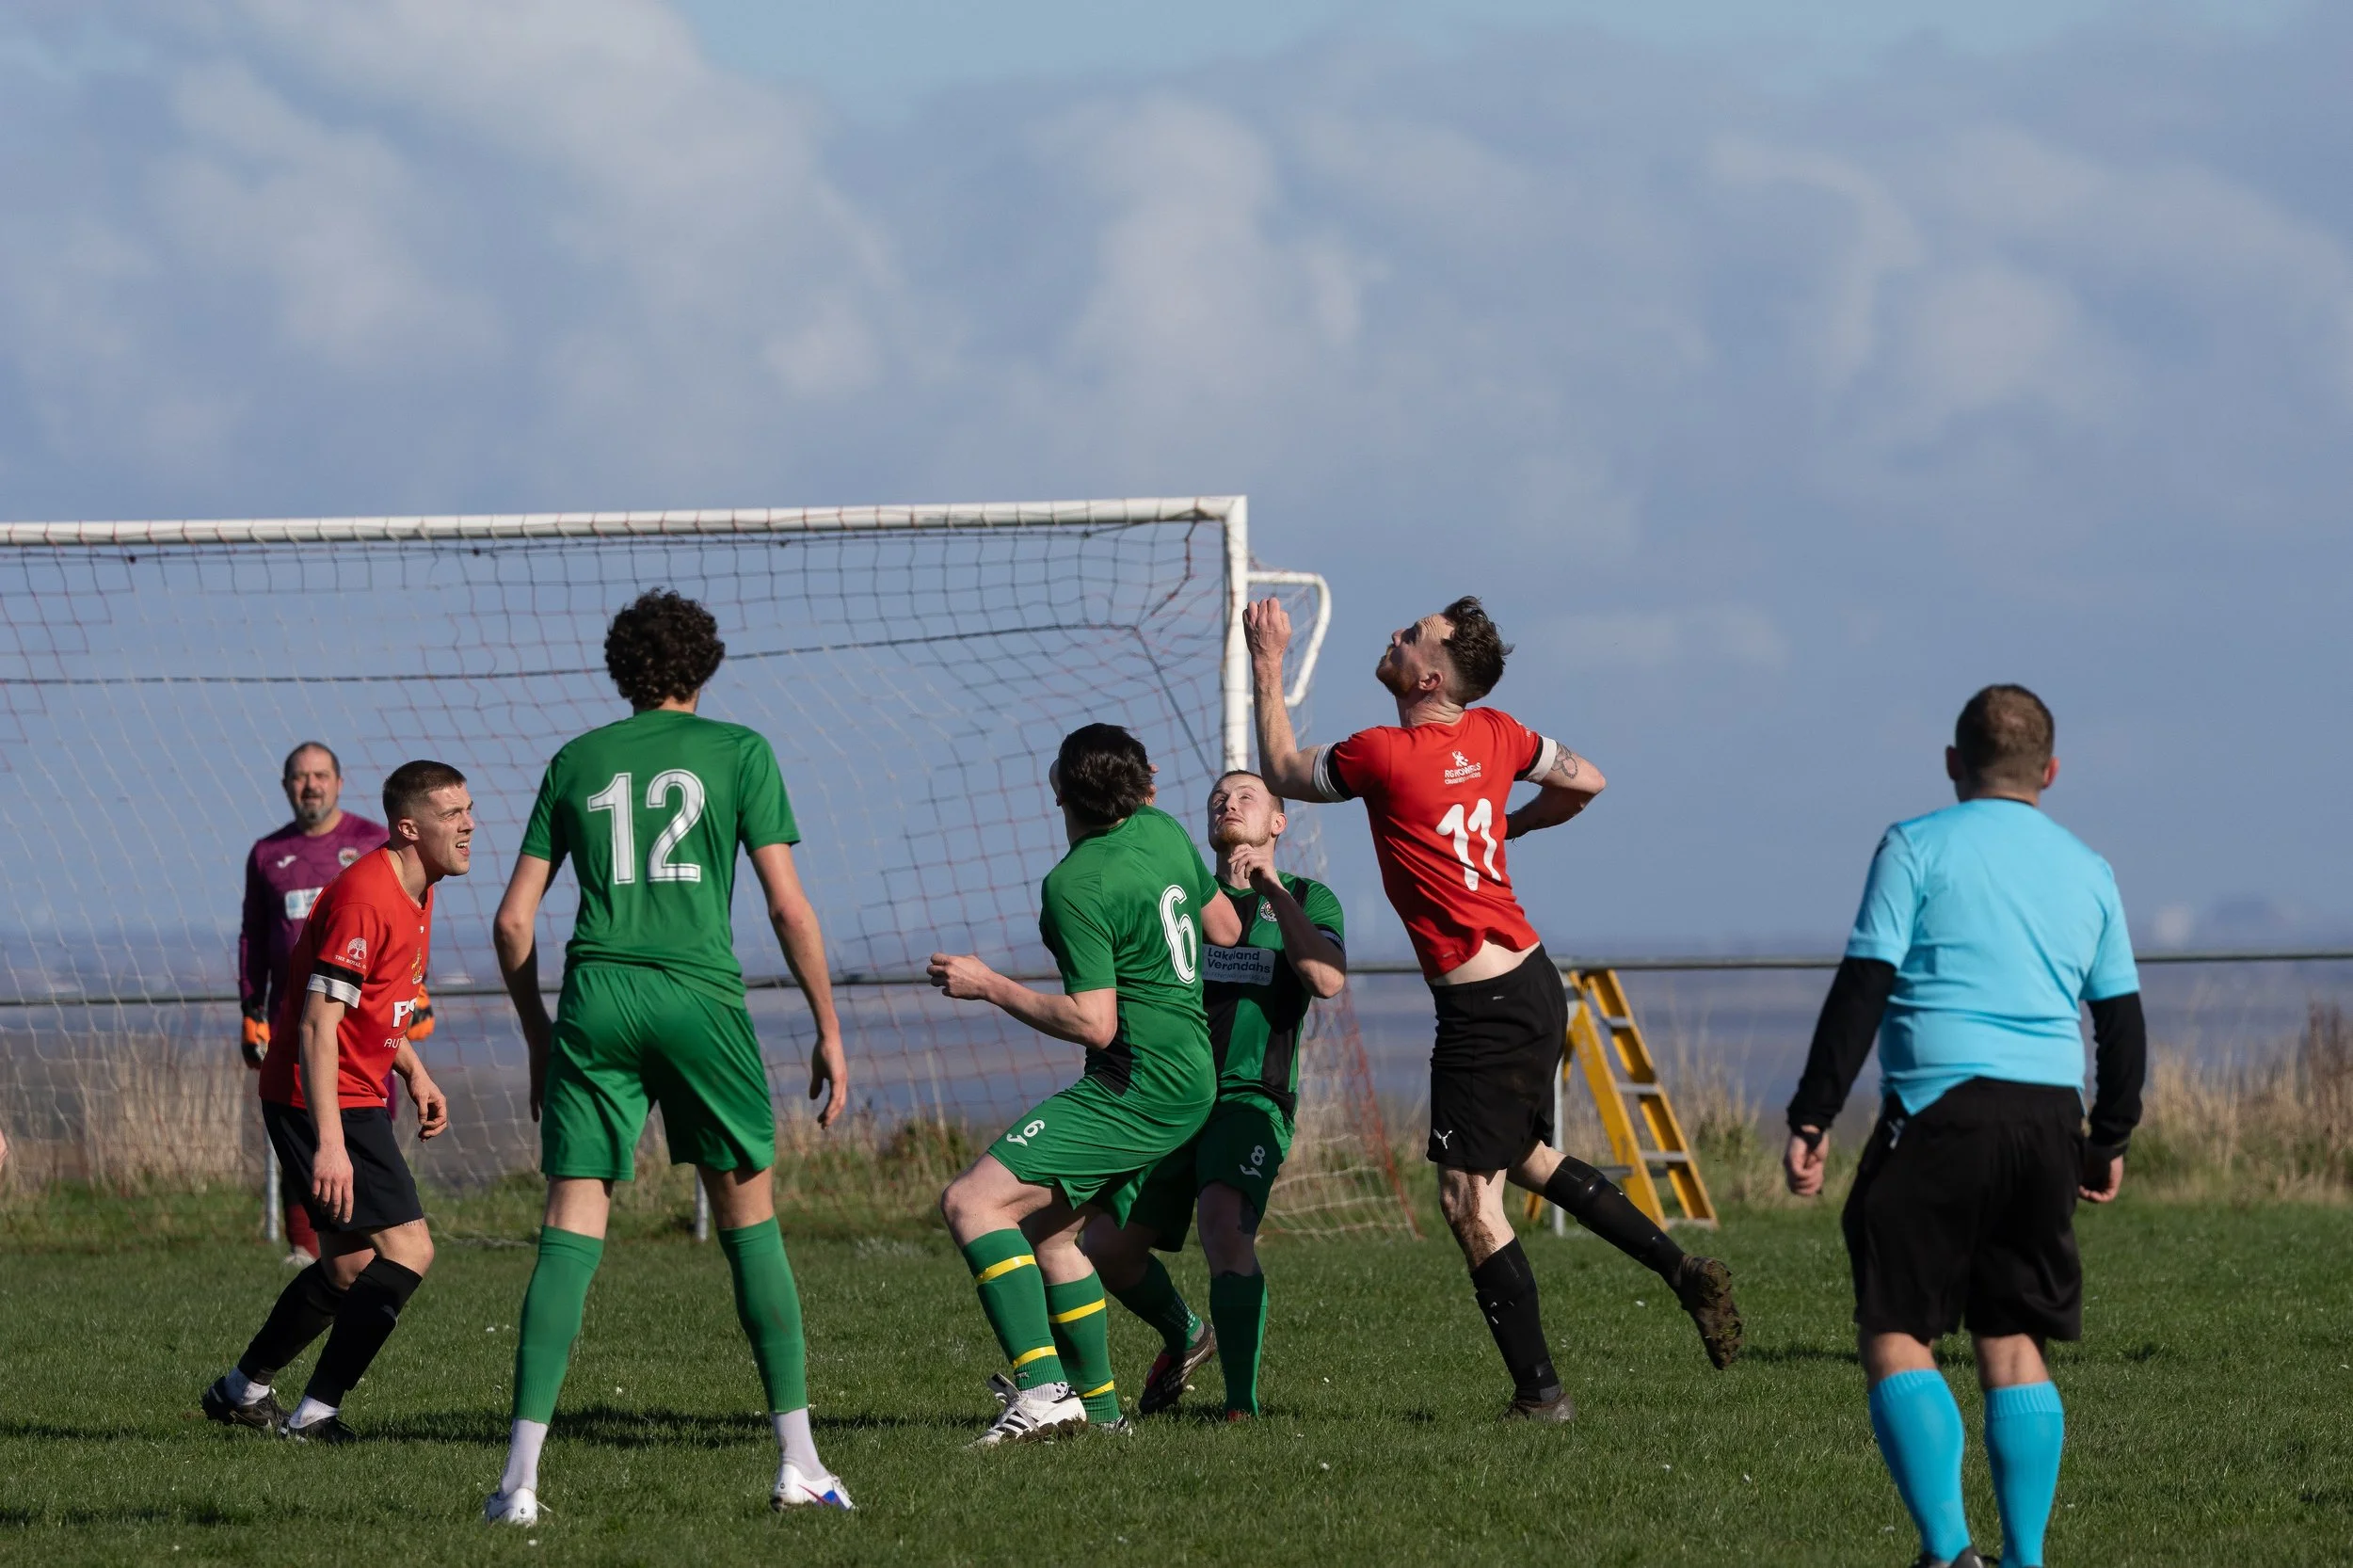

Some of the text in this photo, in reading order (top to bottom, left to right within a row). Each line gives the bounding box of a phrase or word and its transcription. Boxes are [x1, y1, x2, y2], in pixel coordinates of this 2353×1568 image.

[587, 769, 705, 885] 12
[1435, 798, 1502, 891] 11
[1160, 885, 1196, 984] 6
[346, 958, 361, 968] ROYAL
[1208, 947, 1260, 961] Lakeland
[1208, 958, 1271, 974] Verandahs
[1023, 1119, 1046, 1138] 6
[1251, 1144, 1266, 1166] 8
